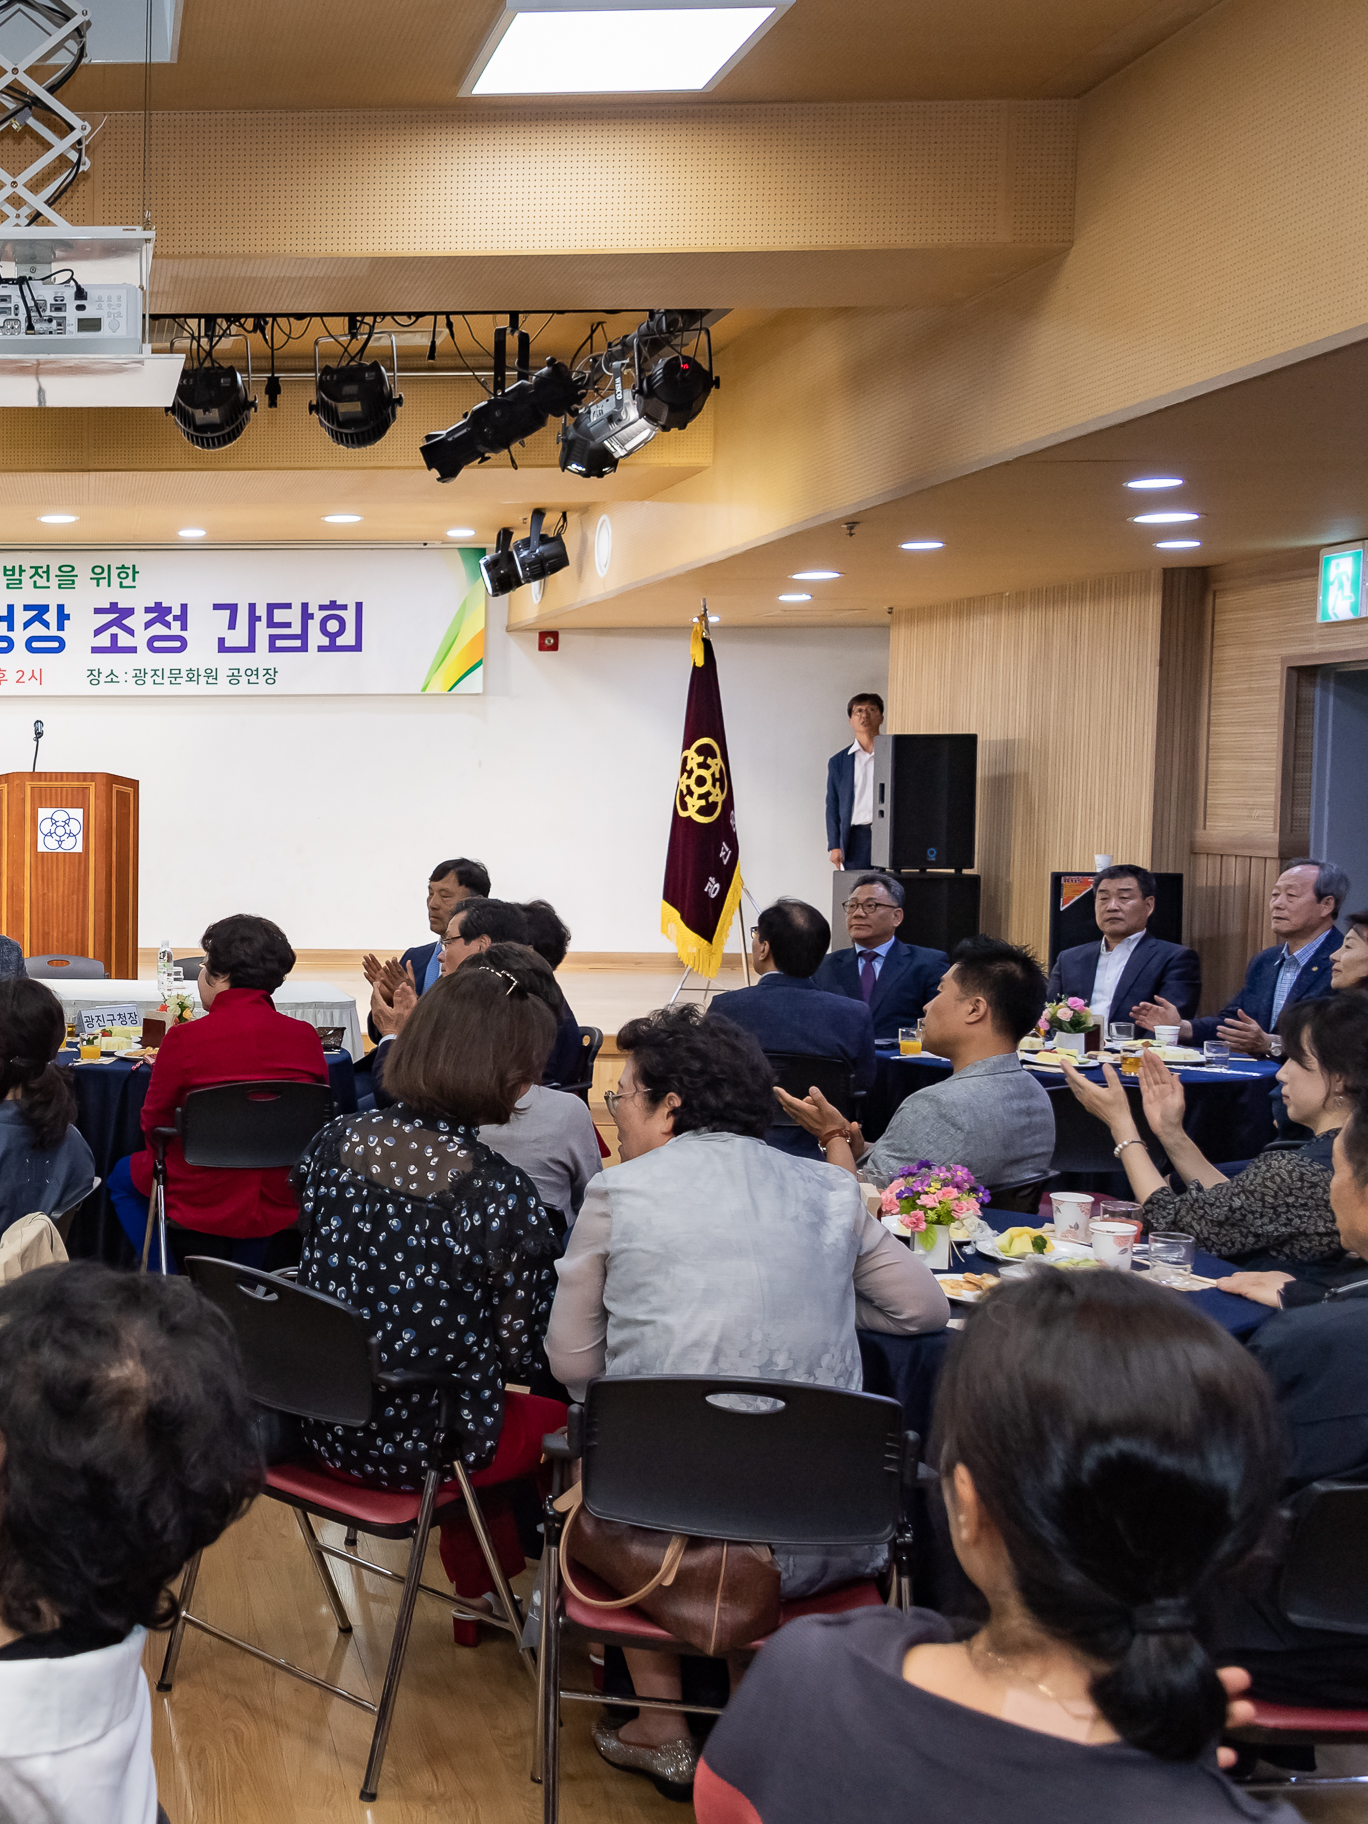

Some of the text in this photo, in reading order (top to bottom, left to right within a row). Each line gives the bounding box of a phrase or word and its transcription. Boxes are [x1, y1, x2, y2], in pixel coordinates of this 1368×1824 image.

[90, 564, 139, 589] 위한
[90, 601, 188, 654] 초청
[212, 600, 364, 654] 간담회
[15, 667, 43, 686] 2시
[226, 667, 279, 686] 공연장
[84, 1012, 138, 1028] 광진구청장
